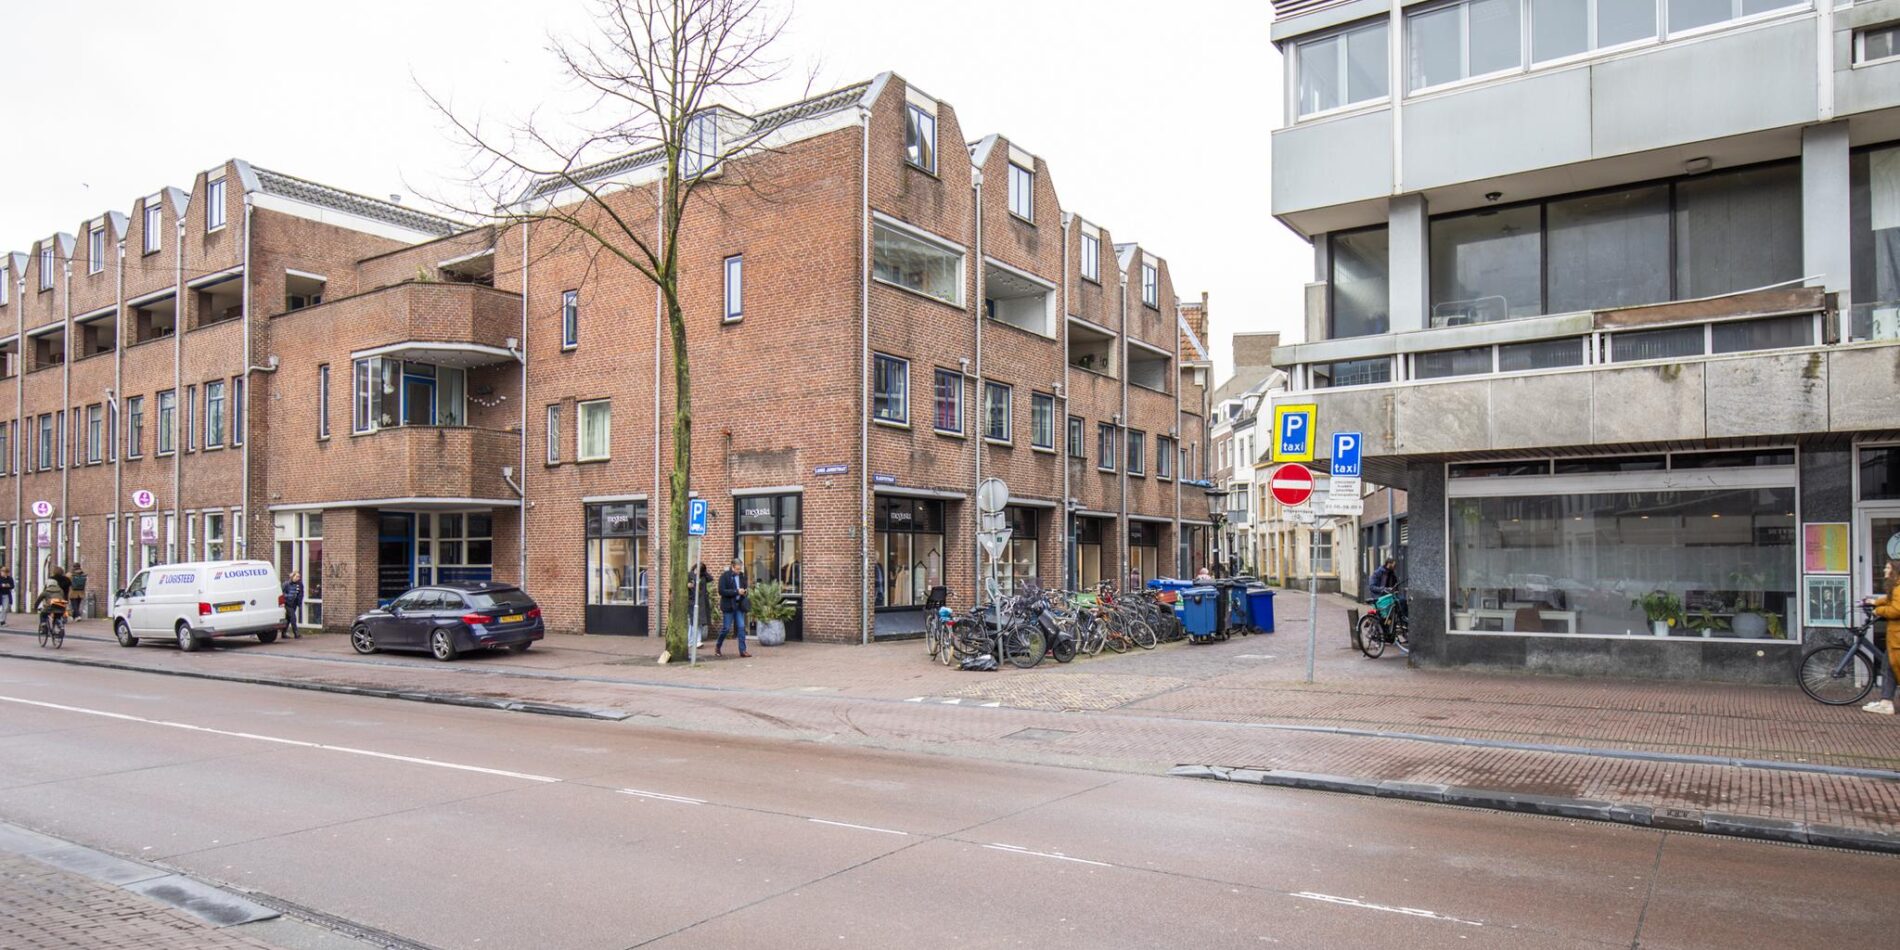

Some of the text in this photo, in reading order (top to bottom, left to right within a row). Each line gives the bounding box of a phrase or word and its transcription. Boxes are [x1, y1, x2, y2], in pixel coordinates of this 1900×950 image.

[1287, 415, 1303, 437] P
[1283, 442, 1304, 451] taxi
[1338, 436, 1355, 459] P
[1334, 463, 1357, 473] taxi
[693, 502, 703, 521] P
[165, 573, 195, 584] LOGISTEED
[224, 568, 268, 578] LOGISTEED
